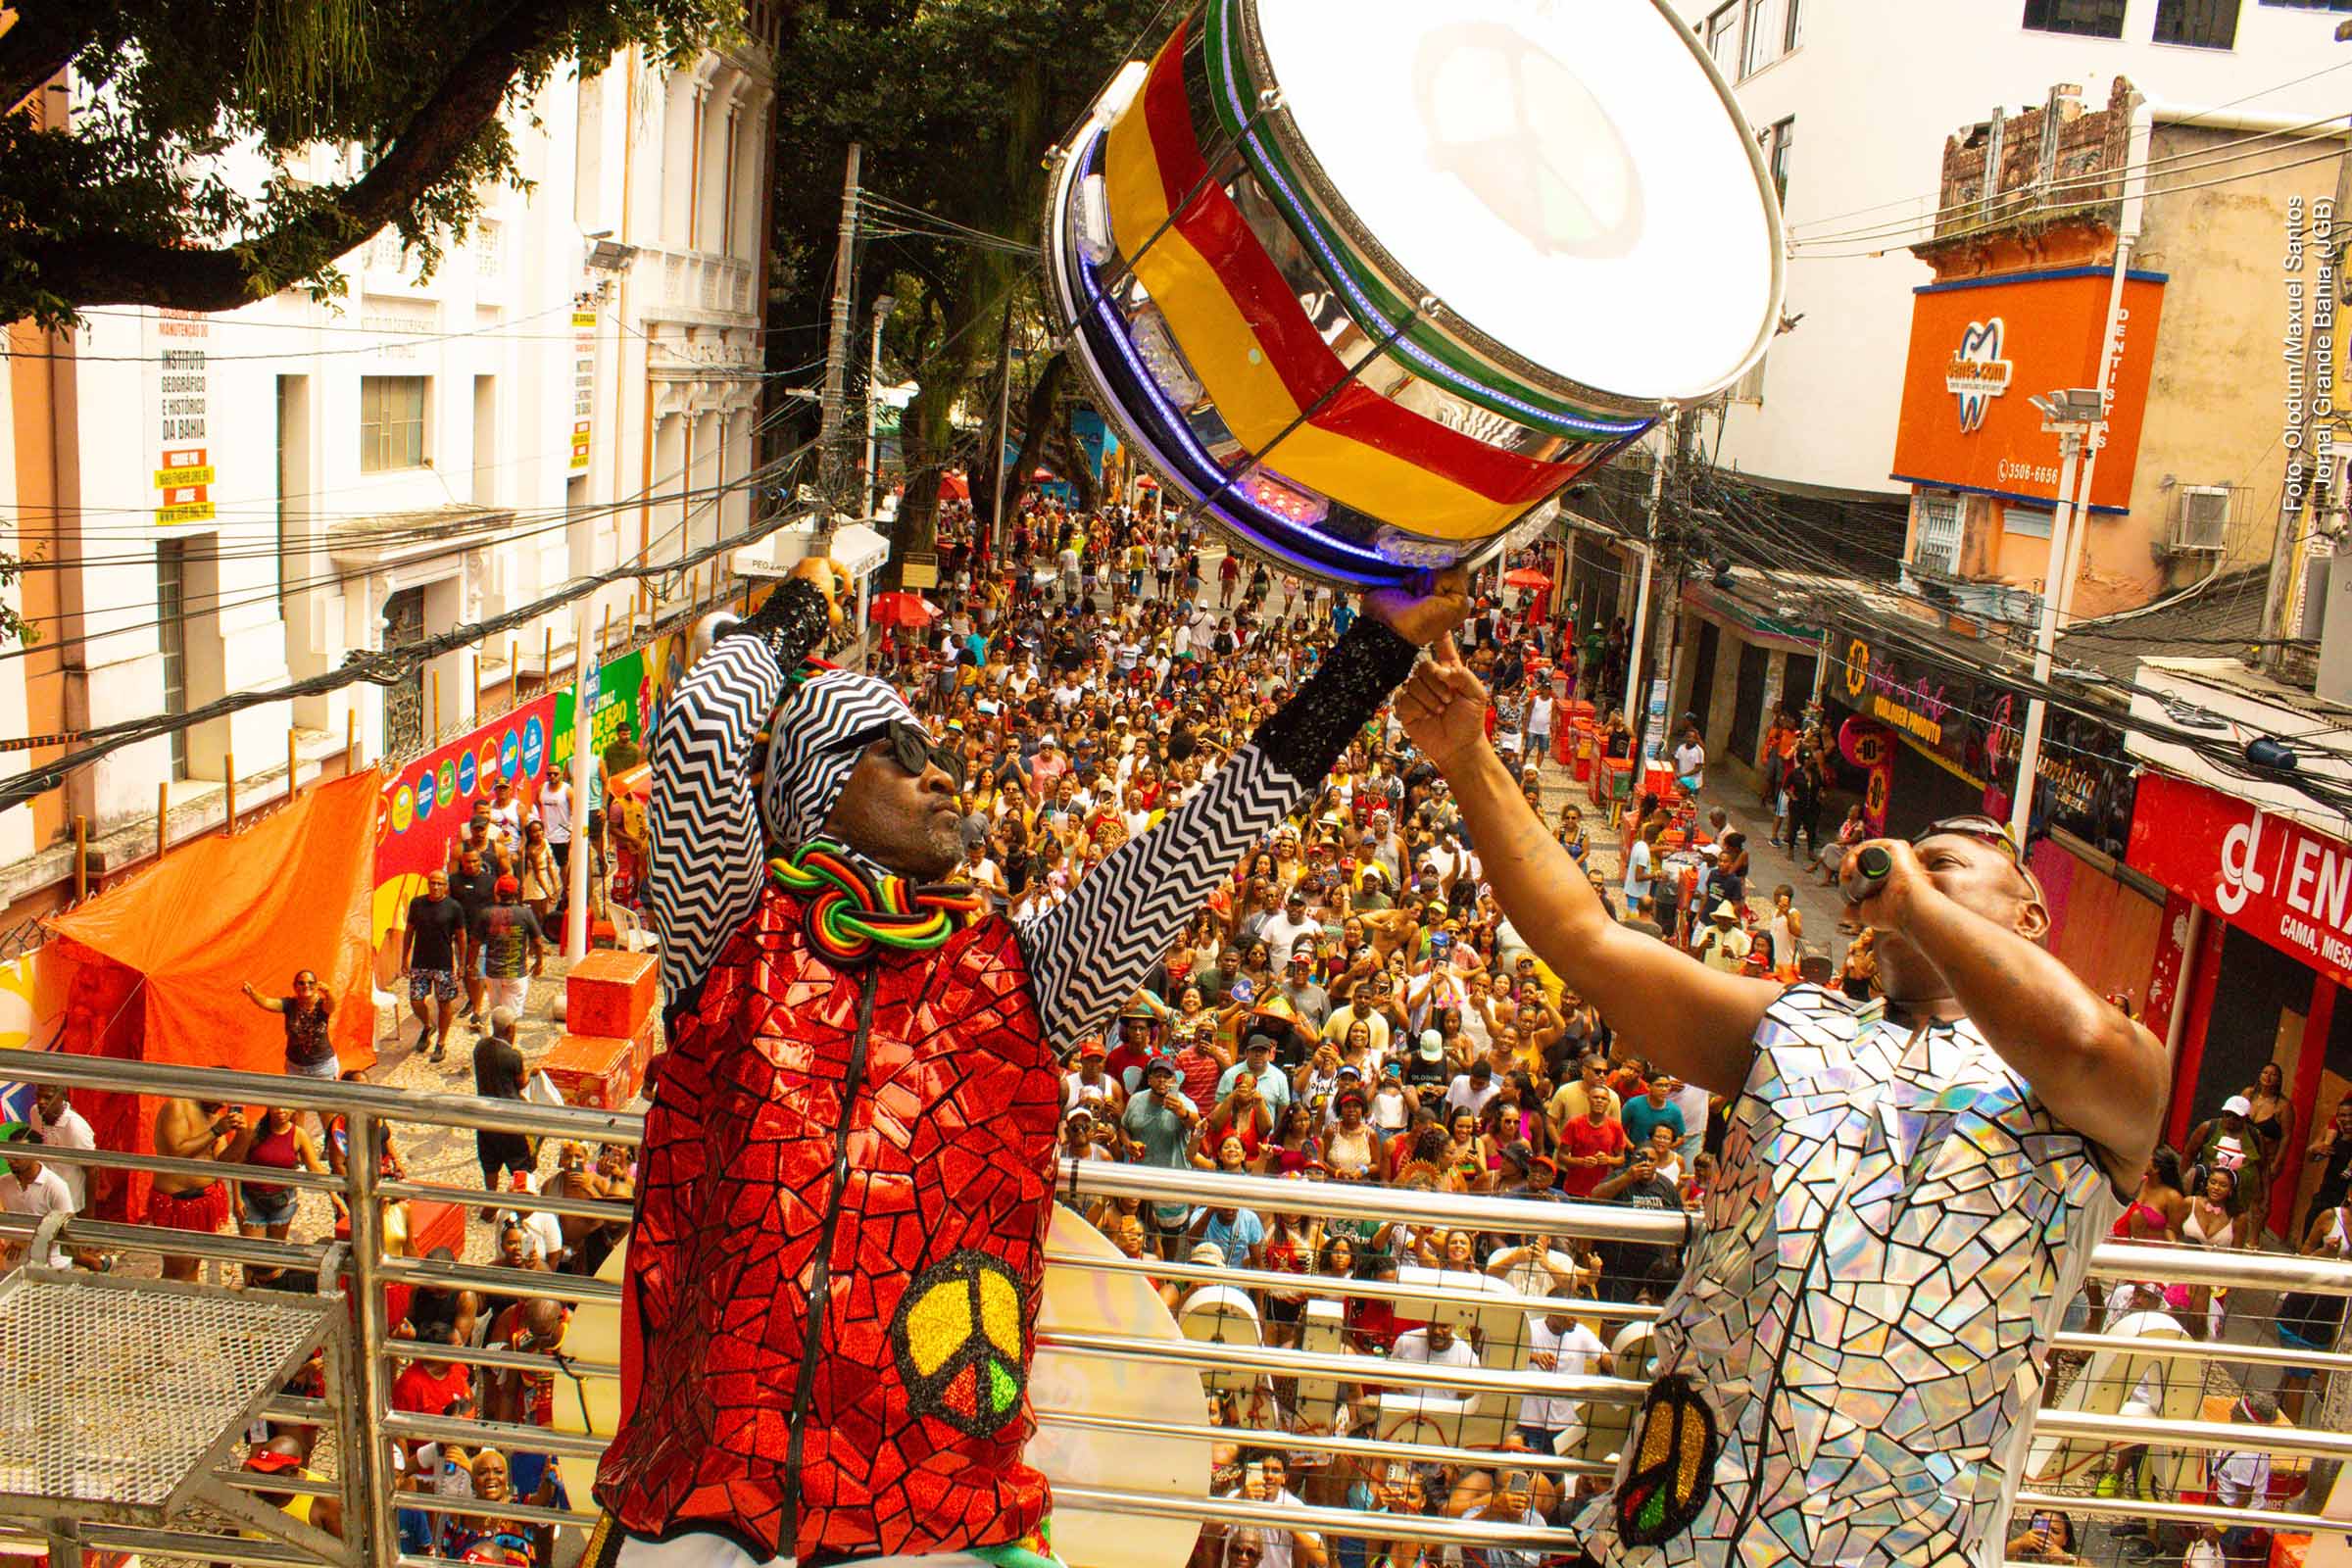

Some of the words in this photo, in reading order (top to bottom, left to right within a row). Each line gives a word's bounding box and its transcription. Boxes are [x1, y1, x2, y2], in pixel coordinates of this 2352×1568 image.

[162, 349, 205, 370] INSTITUTO
[162, 372, 206, 393] GEOGRÁFICO
[2097, 309, 2129, 448] DENTISTAS
[162, 399, 167, 416] E
[169, 396, 206, 416] HISTÓRICO
[163, 419, 175, 440] DA
[178, 418, 206, 440] BAHIA
[1874, 695, 1908, 729] QUALQUER
[1907, 710, 1941, 746] PRODUTO
[2287, 837, 2352, 936] EN
[2280, 914, 2318, 956] CAMA,
[2322, 935, 2352, 970] MES
